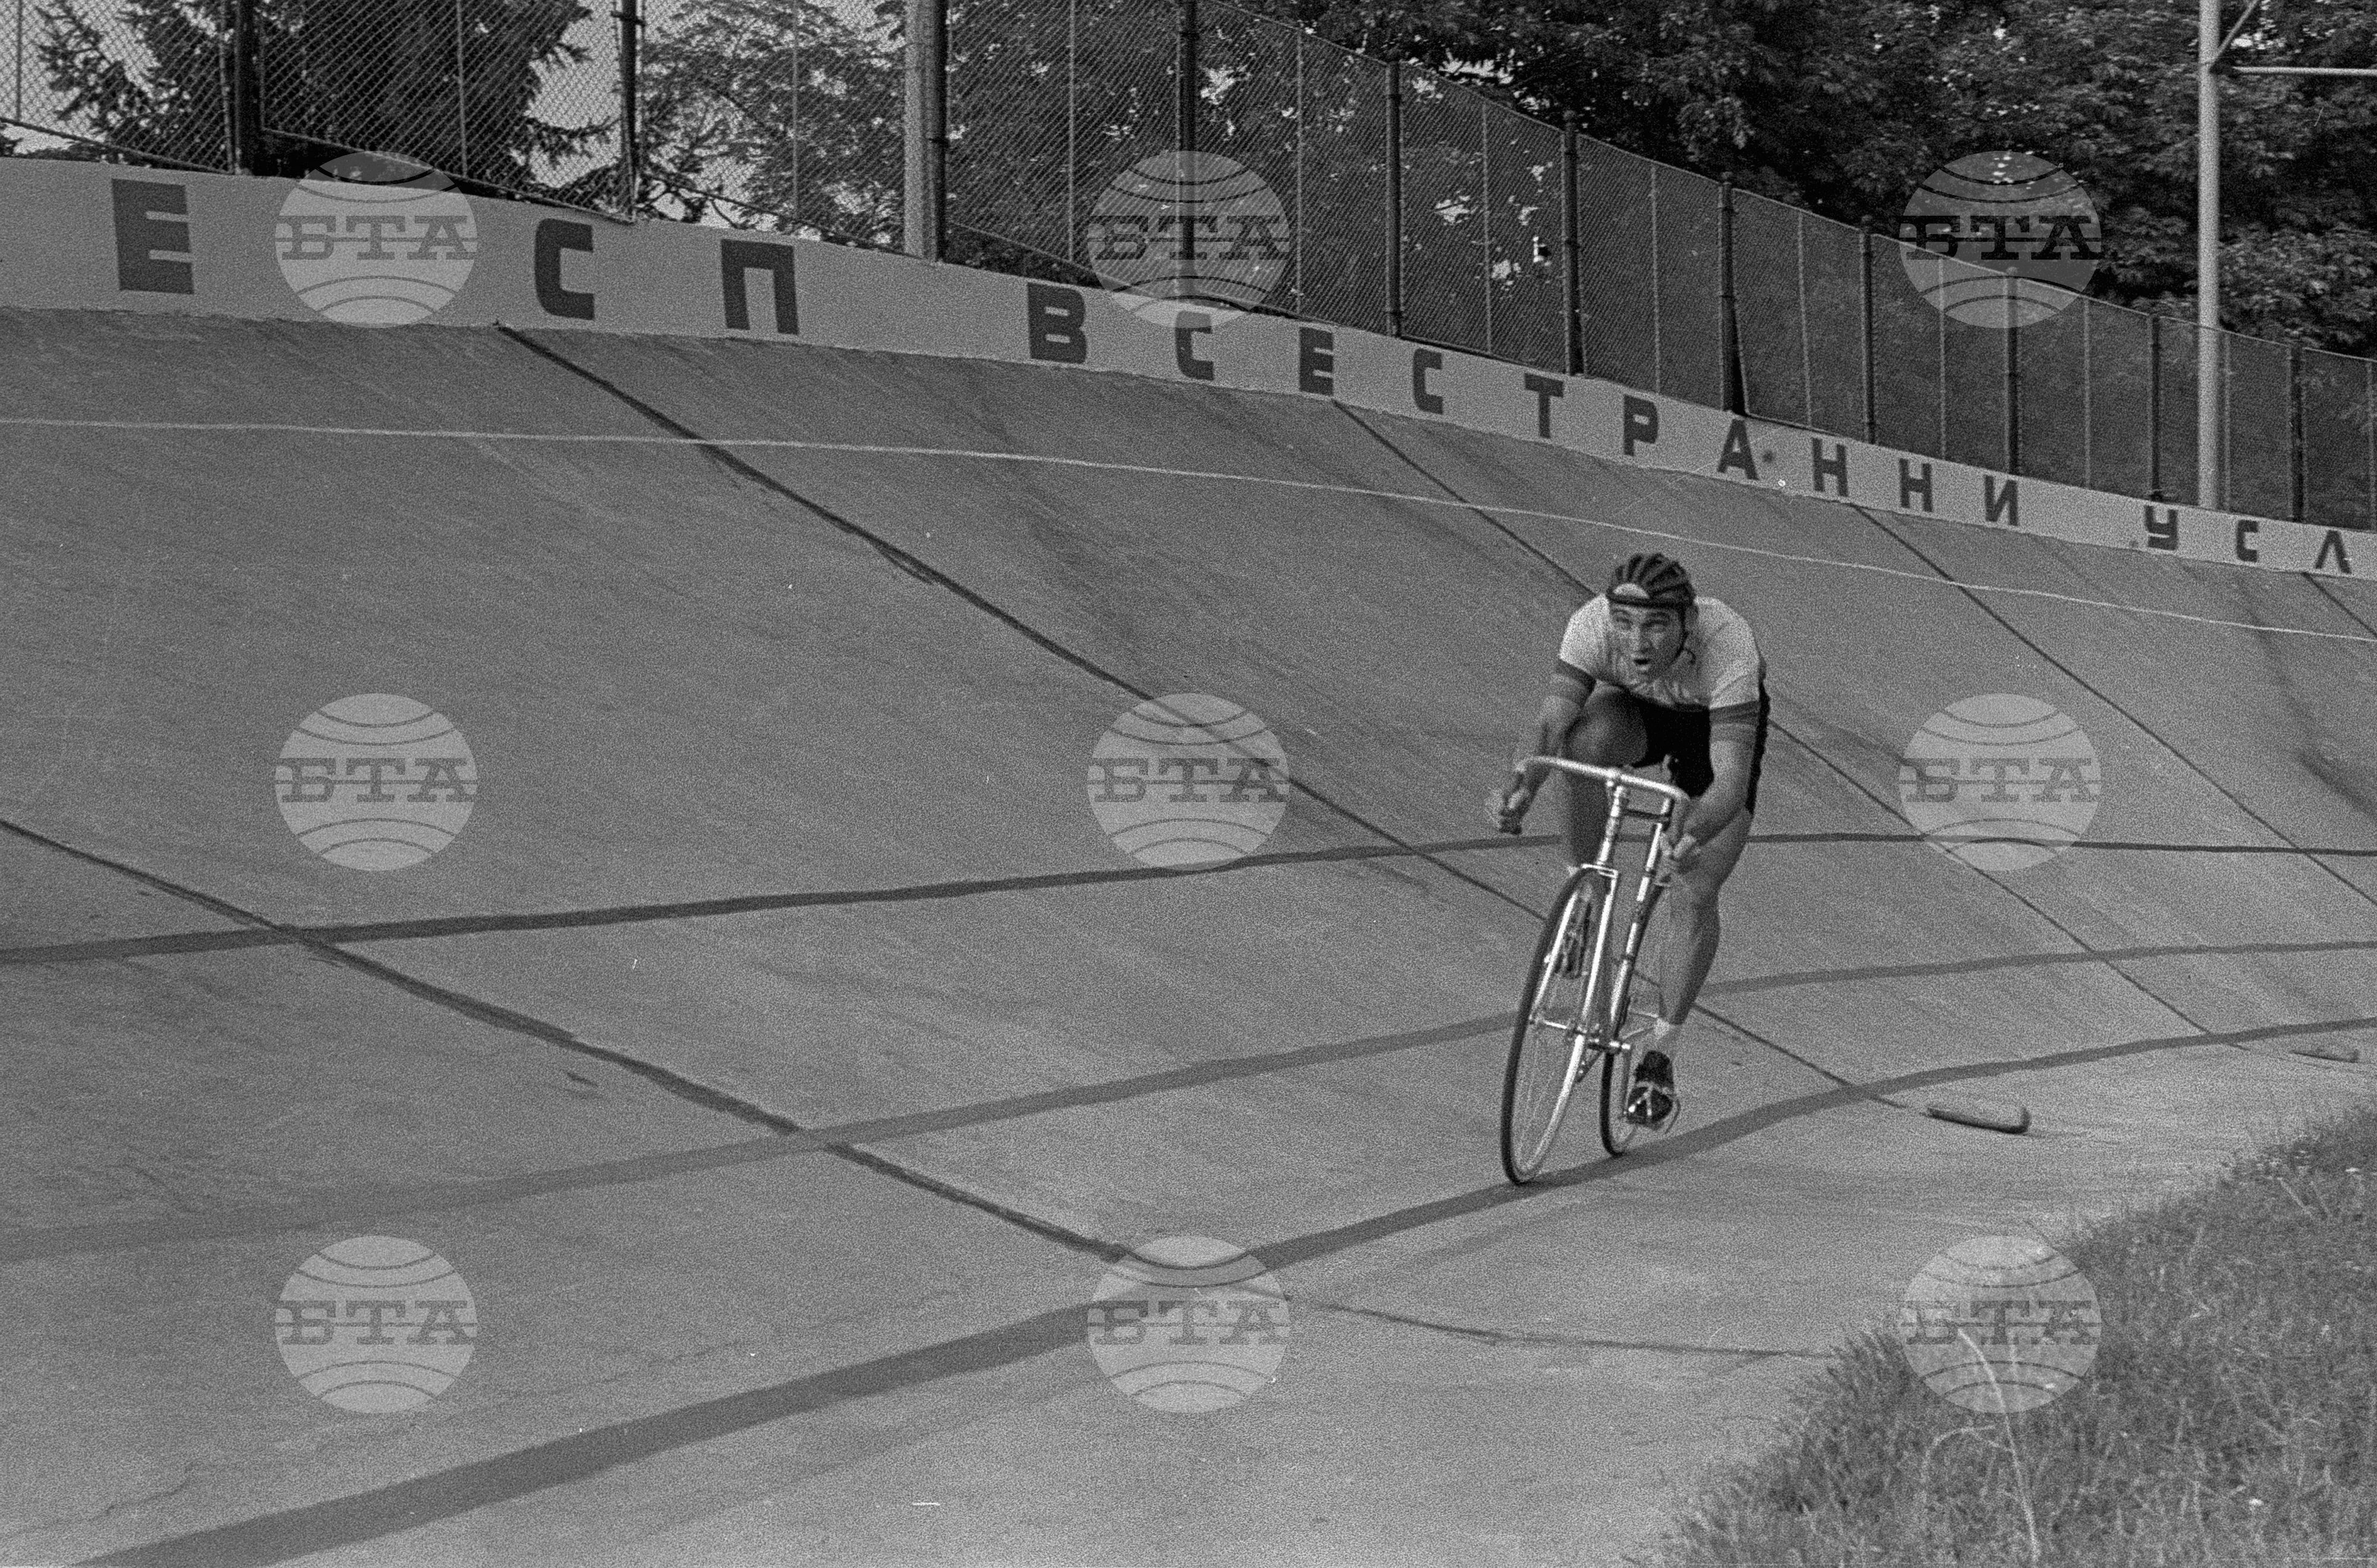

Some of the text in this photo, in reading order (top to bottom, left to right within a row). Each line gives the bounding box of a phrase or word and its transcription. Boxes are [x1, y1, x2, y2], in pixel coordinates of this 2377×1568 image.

[112, 178, 194, 295] Е
[1027, 282, 2019, 526] ВСЕСТРАННИ
[2144, 504, 2352, 575] УСЛ
